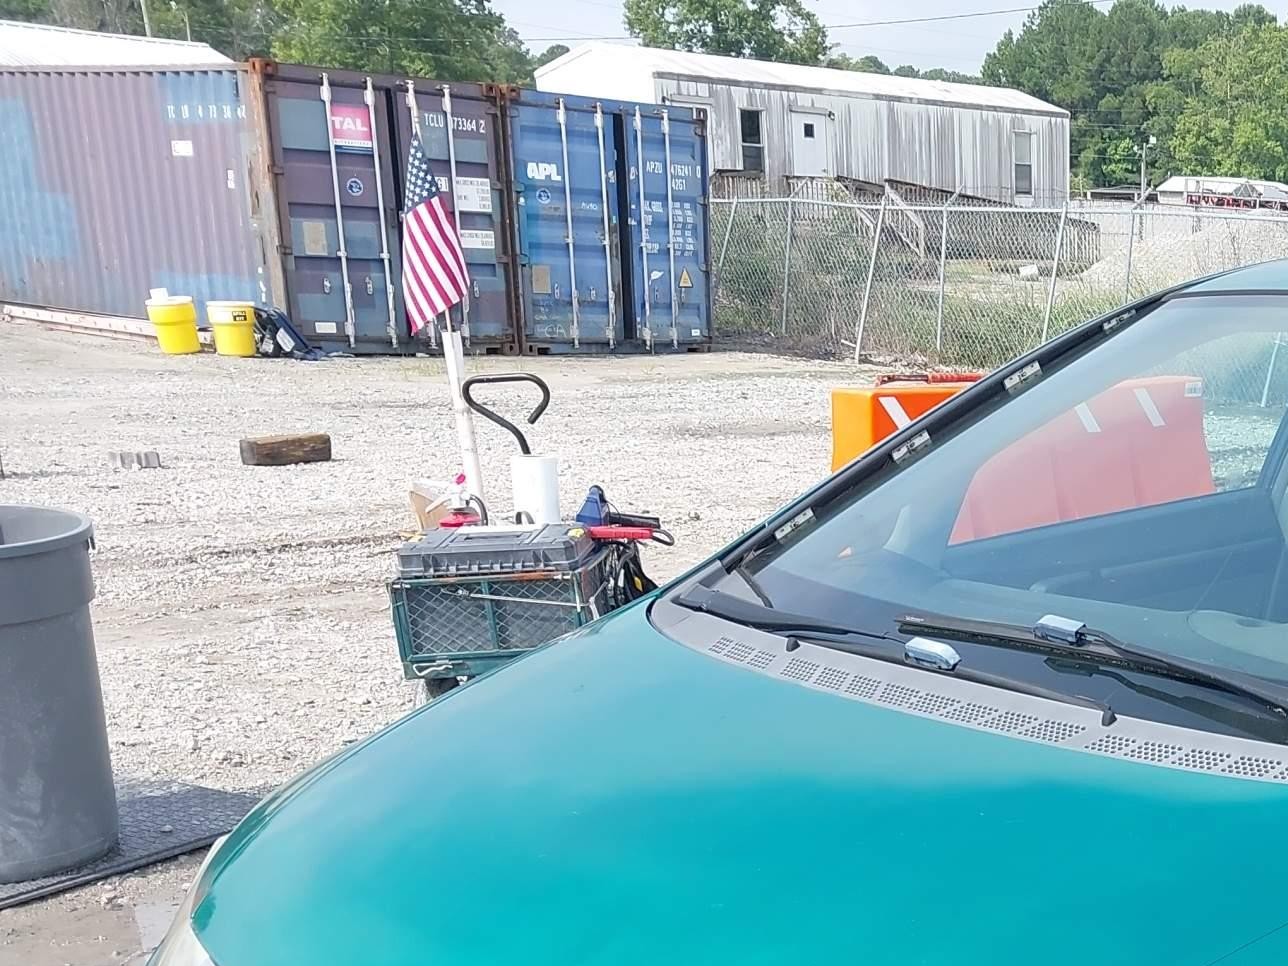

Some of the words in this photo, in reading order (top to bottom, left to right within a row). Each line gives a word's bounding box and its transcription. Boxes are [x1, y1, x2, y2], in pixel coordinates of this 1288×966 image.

[332, 117, 368, 131] TAL
[424, 113, 444, 128] TCLU
[479, 120, 486, 133] 2
[527, 162, 562, 181] APL
[646, 161, 662, 174] APZU
